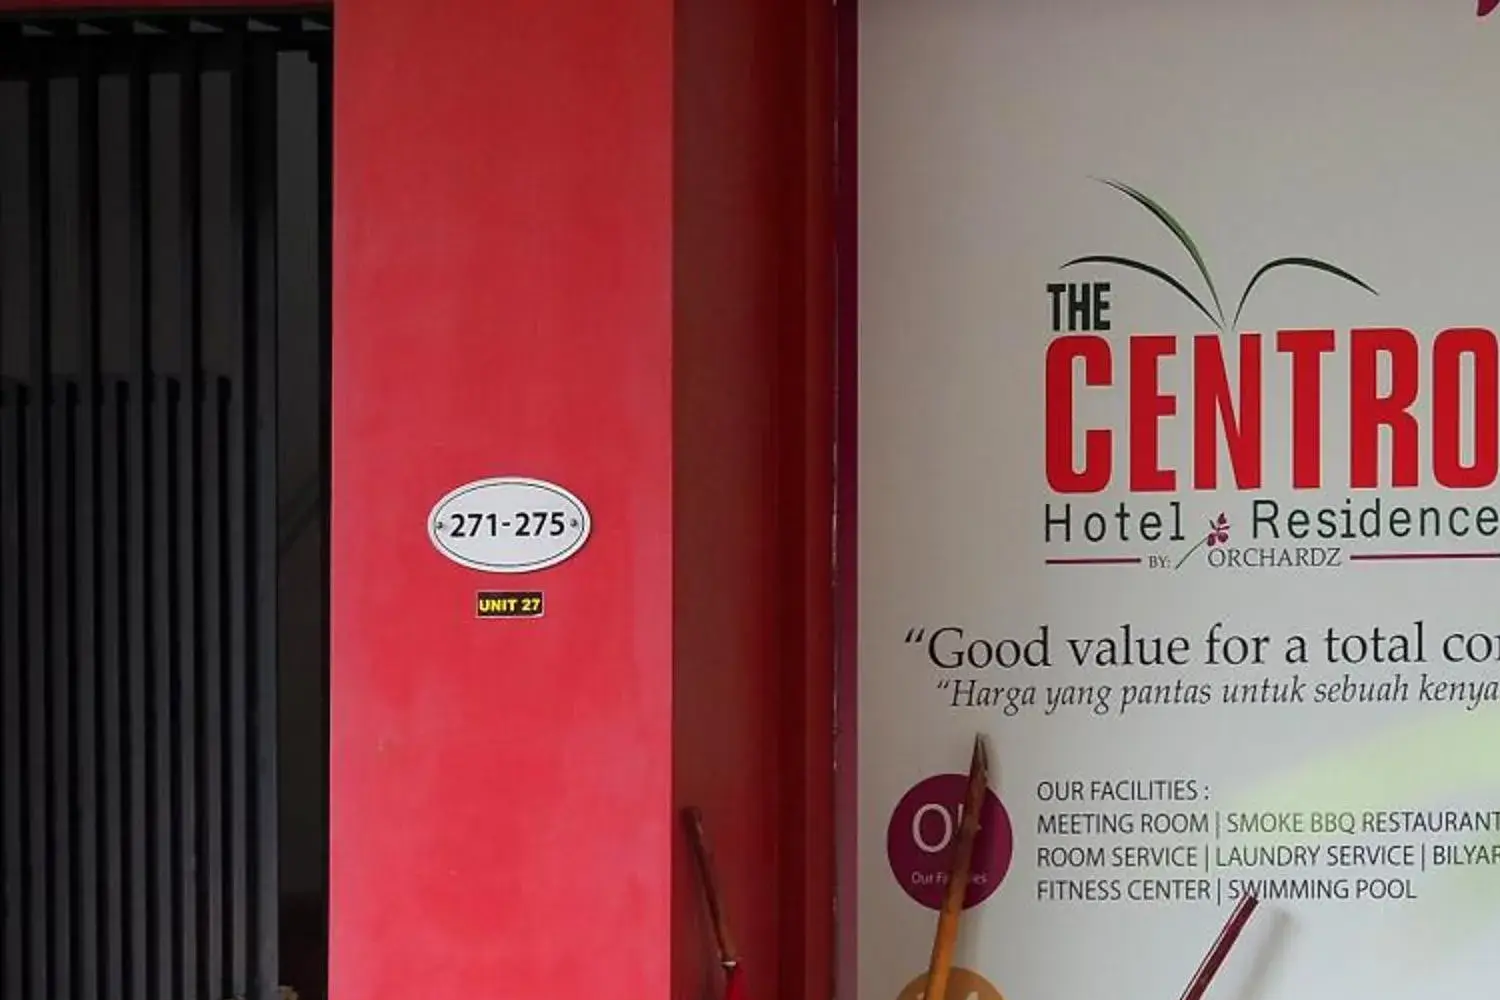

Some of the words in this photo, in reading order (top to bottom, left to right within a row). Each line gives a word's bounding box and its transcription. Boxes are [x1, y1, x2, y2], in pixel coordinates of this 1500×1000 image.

[1047, 283, 1111, 332] THE
[1046, 327, 1500, 493] CENTRO
[450, 512, 566, 538] 271-275
[1045, 501, 1186, 545] Hotel
[1251, 497, 1499, 543] Residence
[1207, 545, 1343, 568] ORCHARDZ
[479, 598, 518, 612] UNIT
[521, 598, 541, 612] 27
[1066, 624, 1191, 670] value
[1202, 622, 1271, 670] for
[1283, 635, 1311, 668] a
[1321, 620, 1427, 668] total
[1043, 675, 1112, 715] yang
[1118, 674, 1214, 714] pantas
[1219, 672, 1308, 704] untuk
[1311, 672, 1413, 703] sebuah
[1037, 781, 1086, 803] OUR
[1088, 779, 1200, 803] FACILITIES
[1038, 811, 1136, 837] MEETING
[1139, 811, 1211, 837] ROOM
[1225, 813, 1305, 836] SMOKE
[1310, 812, 1357, 837] BBQ
[1037, 845, 1107, 869] ROOM
[1109, 845, 1200, 869] SERVICE
[1215, 843, 1322, 869] LAUNDRY
[1325, 843, 1416, 868] SERVICE
[1037, 878, 1123, 901] FITNESS
[1125, 878, 1213, 901] CENTER
[1228, 879, 1349, 900] SWIMMING
[1355, 877, 1417, 900] POOL
